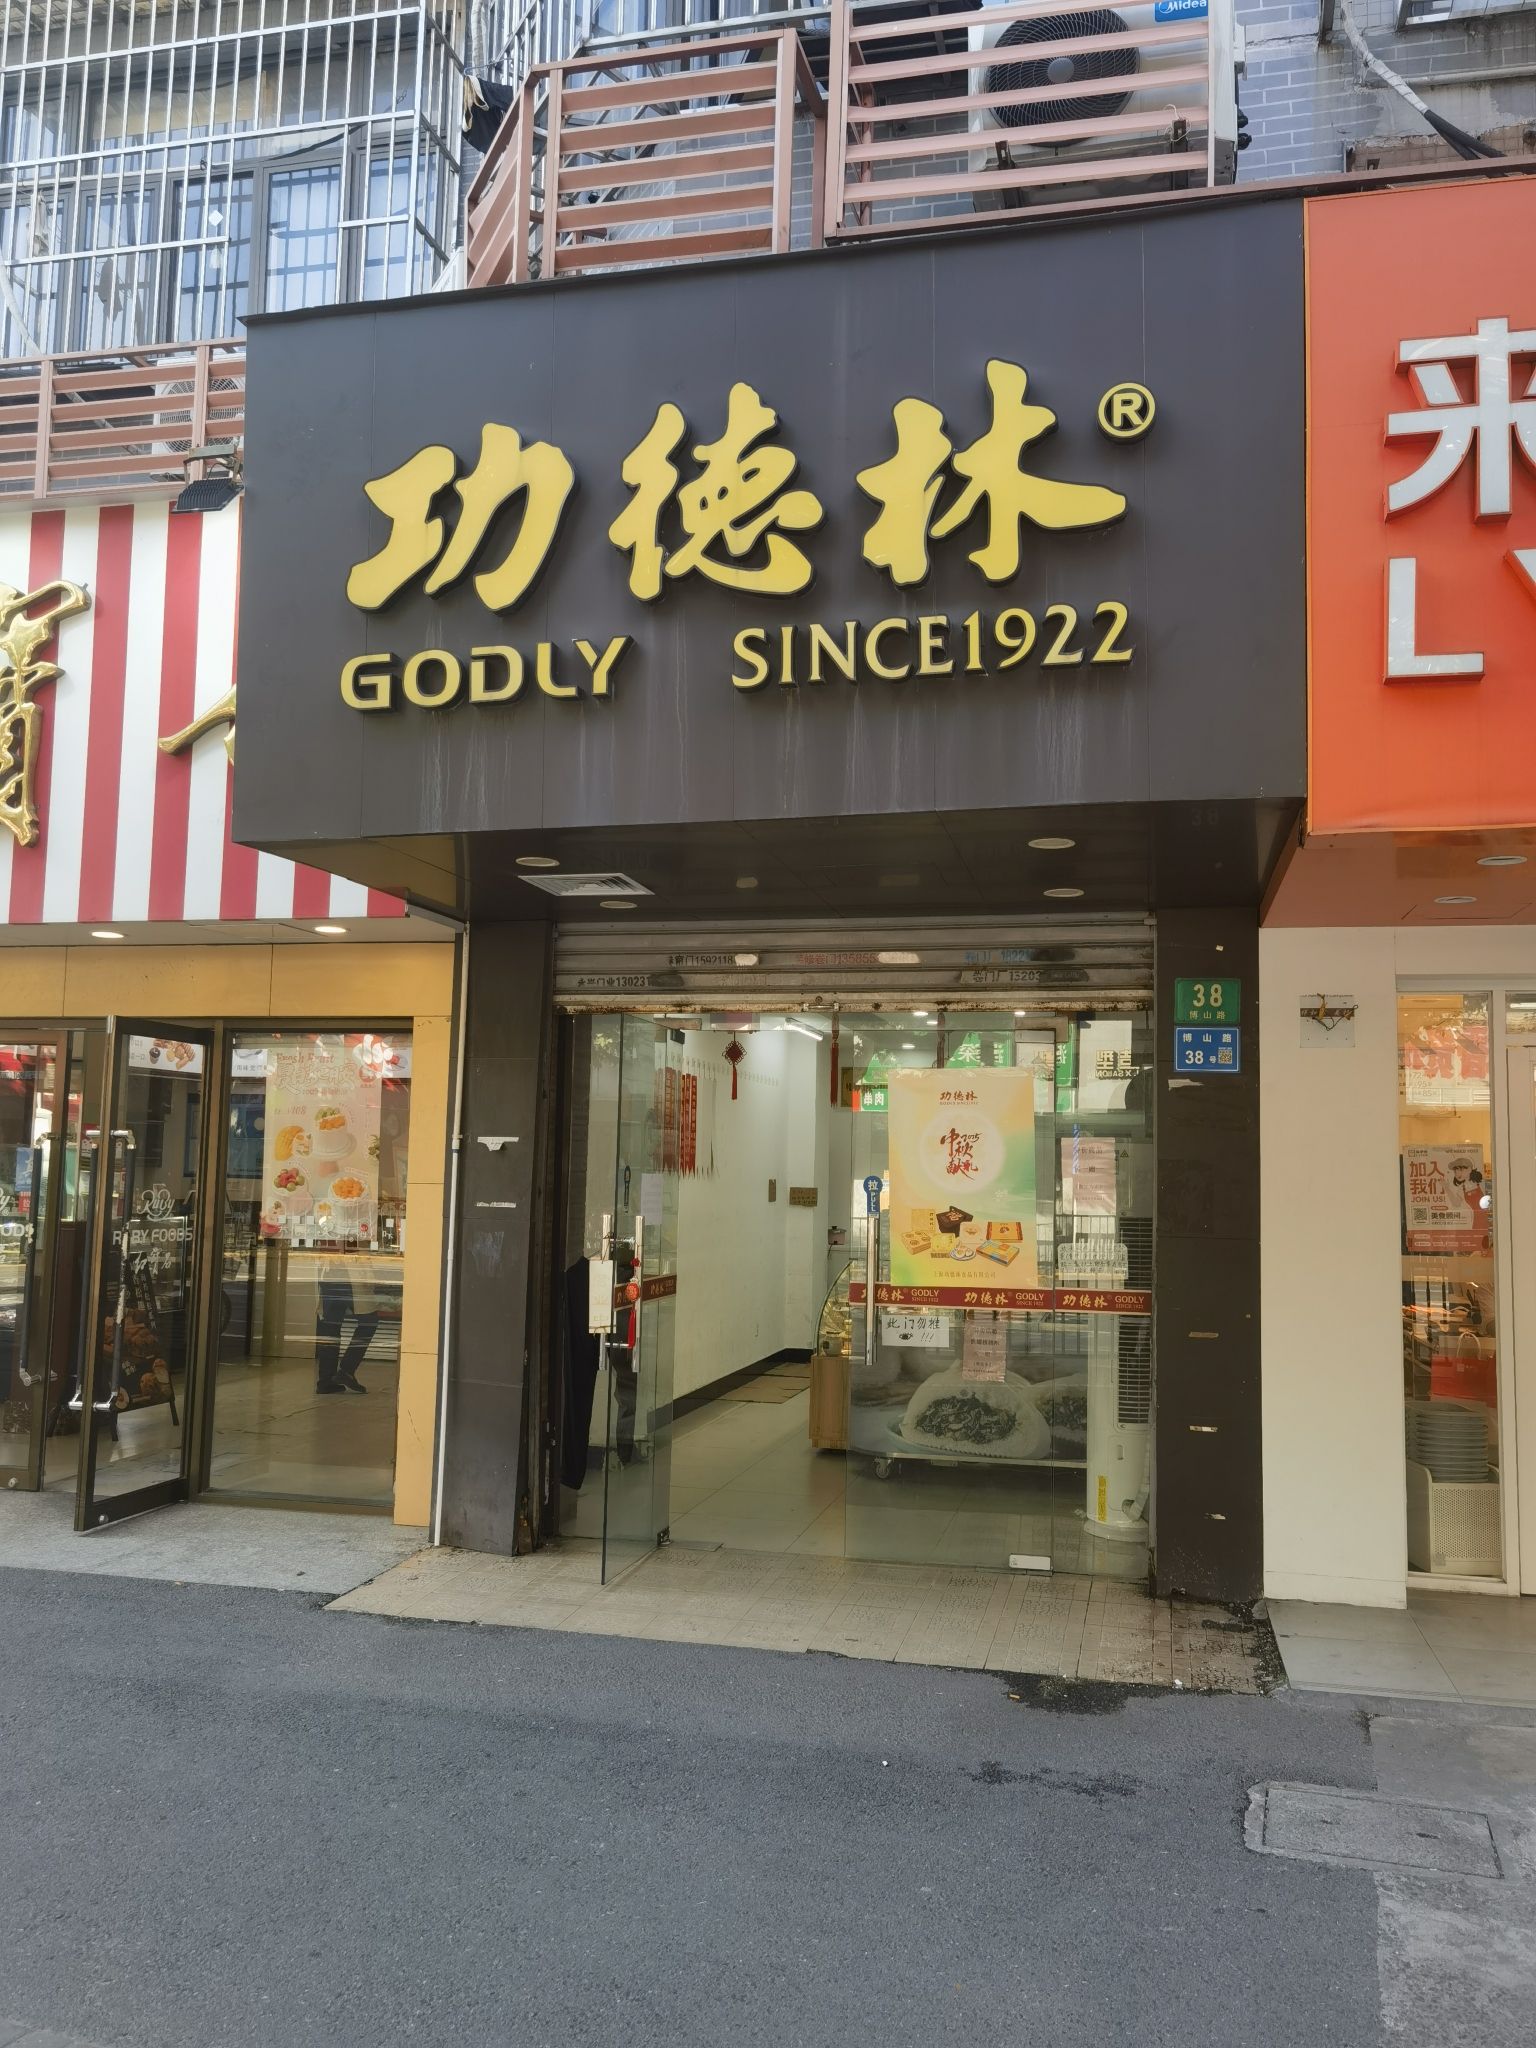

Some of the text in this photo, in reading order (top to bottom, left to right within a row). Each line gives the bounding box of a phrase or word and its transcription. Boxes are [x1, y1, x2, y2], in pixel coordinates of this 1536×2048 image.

[347, 359, 1125, 611] 功德林
[731, 602, 1132, 690] SINCE1922
[340, 636, 630, 710] GODLY
[1192, 983, 1223, 1007] 38
[1190, 1010, 1226, 1020] 博山路
[1183, 1033, 1232, 1043] 博山路
[939, 1090, 979, 1102] 功德林
[1409, 1160, 1445, 1178] 加入
[867, 1179, 879, 1191] 拉
[1409, 1178, 1446, 1195] 我们
[1411, 1195, 1430, 1203] JOIN
[112, 1227, 194, 1246] RBY FOODS
[911, 1288, 940, 1297] GODLY
[964, 1291, 1009, 1305] 功德林
[1015, 1292, 1044, 1301] GODLY
[1115, 1295, 1145, 1304] GODLY
[1062, 1294, 1108, 1308] 功德林
